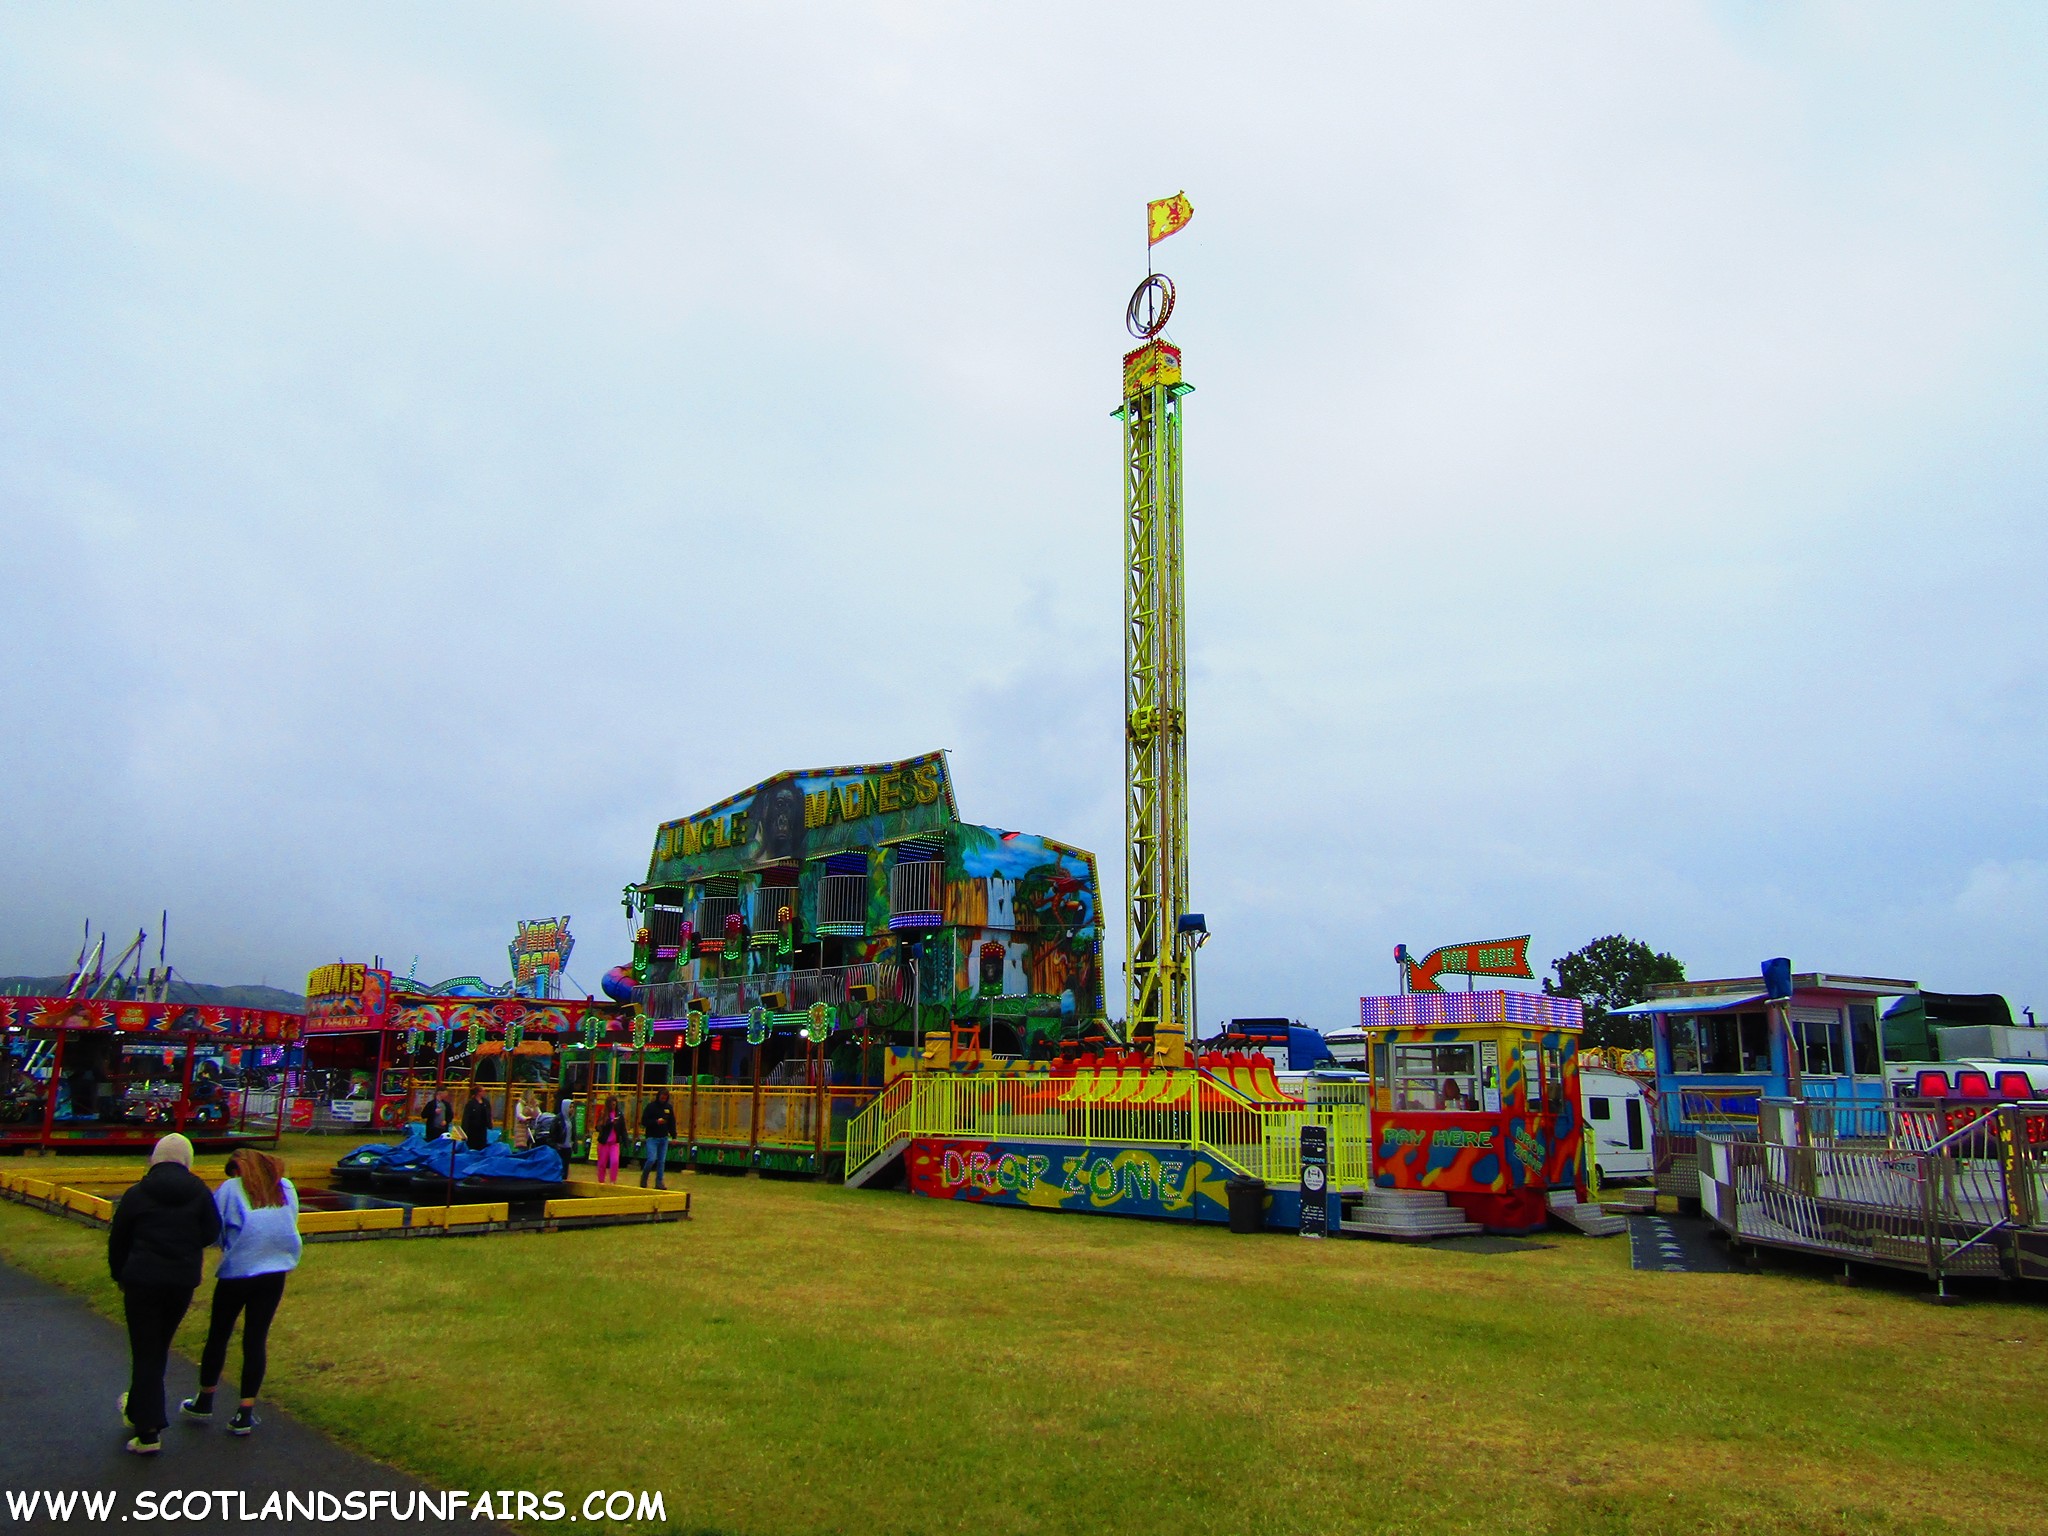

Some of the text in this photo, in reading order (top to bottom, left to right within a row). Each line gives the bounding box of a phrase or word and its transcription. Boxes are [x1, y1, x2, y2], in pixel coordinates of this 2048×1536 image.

[659, 765, 939, 861] JUNGLE MADNESS
[526, 922, 557, 951] AIR
[1441, 947, 1517, 970] PAY HERE
[1383, 1128, 1493, 1149] PAY HERE
[1515, 1126, 1545, 1159] DROP
[943, 1150, 1184, 1201] DROP ZONE
[1513, 1143, 1543, 1178] ZONE
